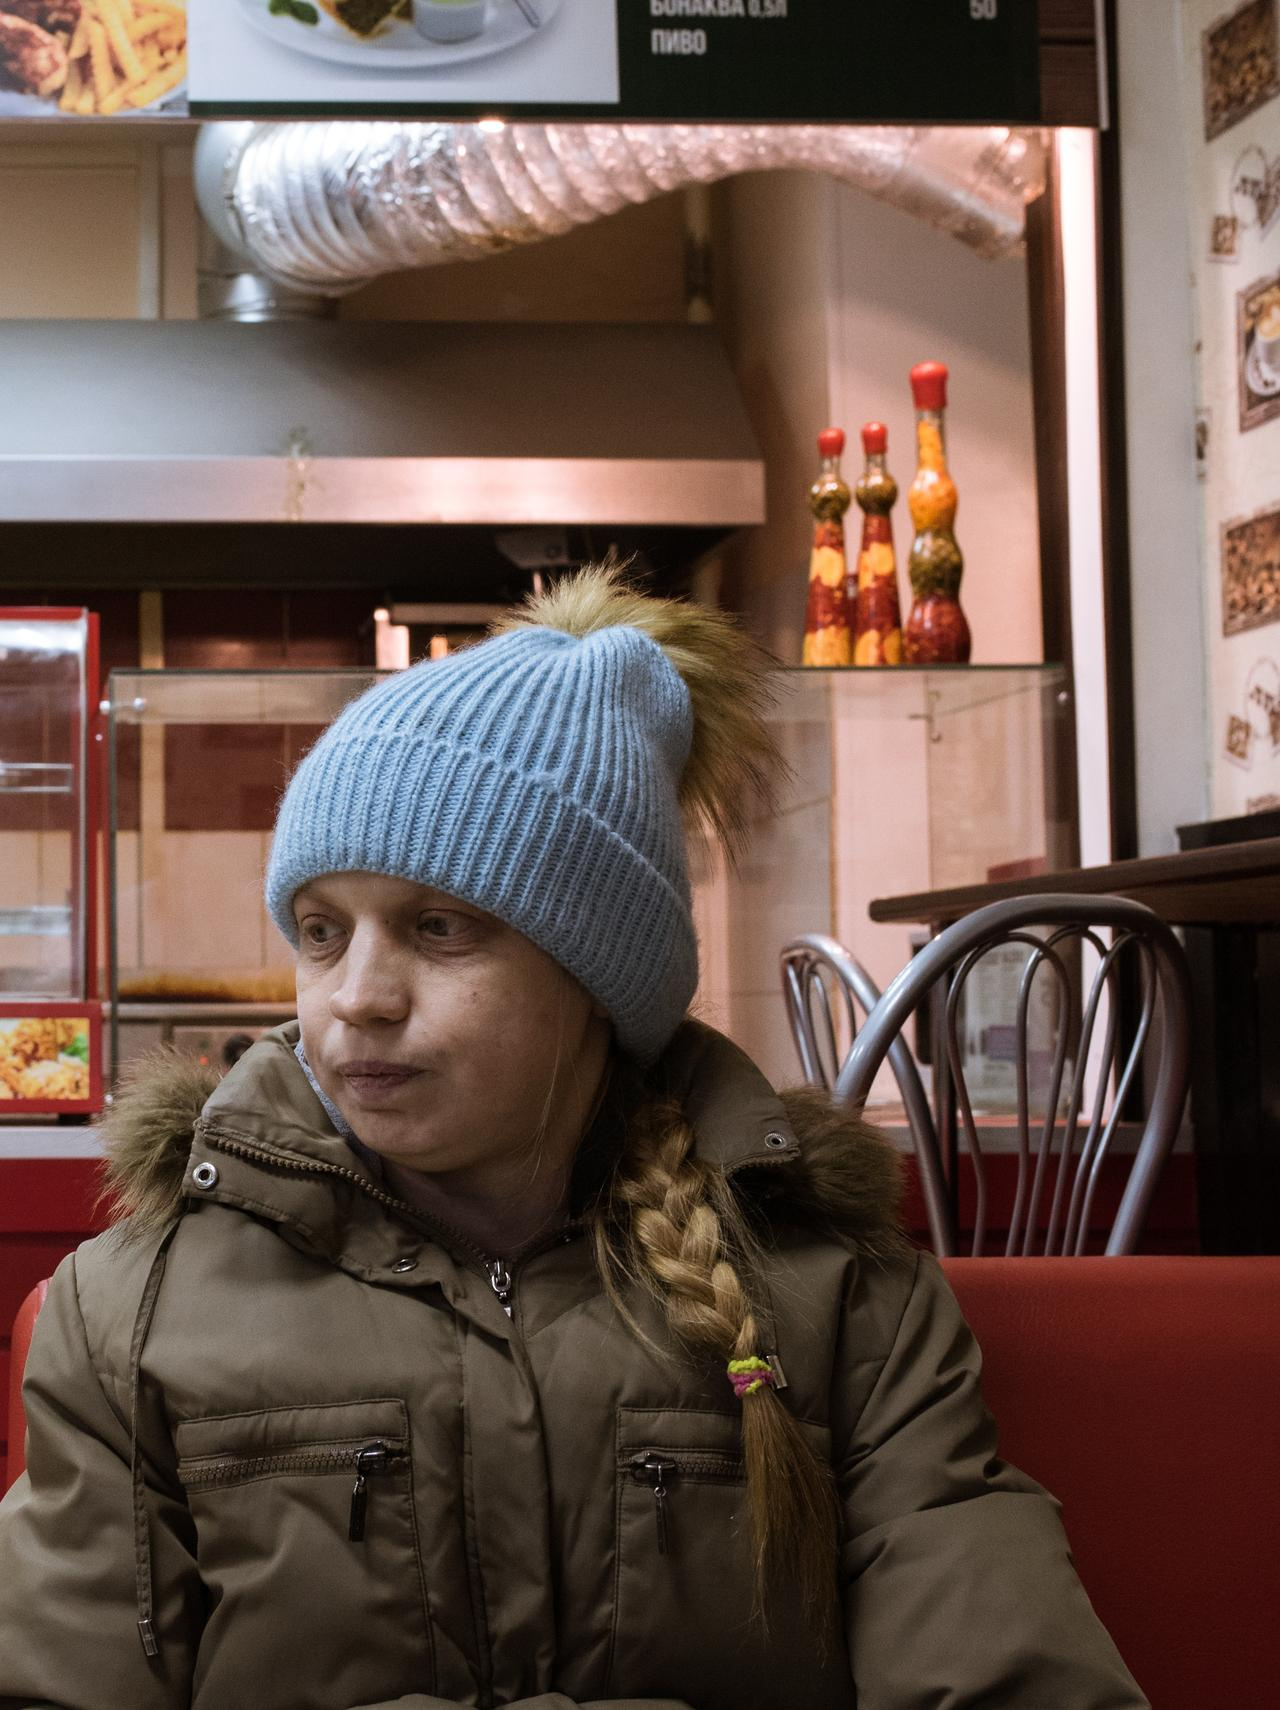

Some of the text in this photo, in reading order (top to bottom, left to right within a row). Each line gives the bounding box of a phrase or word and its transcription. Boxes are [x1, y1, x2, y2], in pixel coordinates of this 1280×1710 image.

[650, 0, 745, 17] БОНАКВА
[969, 0, 997, 20] 50
[650, 28, 707, 55] ПИВО
